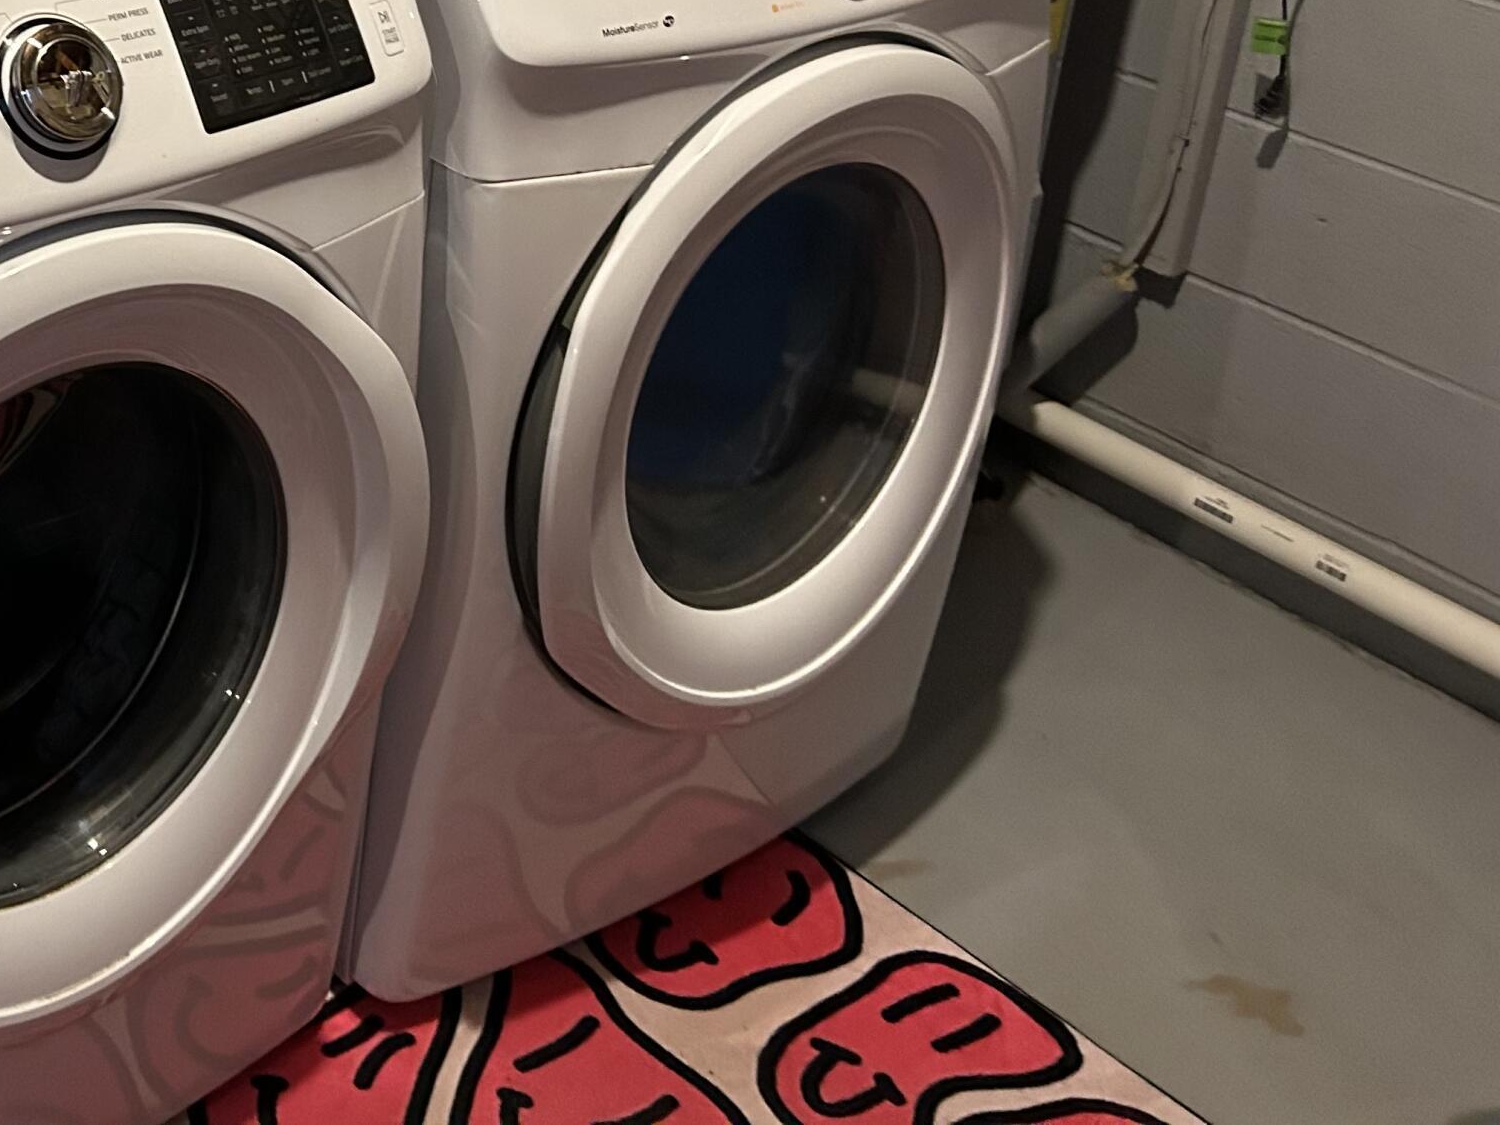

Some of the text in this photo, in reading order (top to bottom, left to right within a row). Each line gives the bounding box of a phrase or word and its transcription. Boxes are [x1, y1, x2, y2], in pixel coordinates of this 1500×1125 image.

[108, 7, 149, 21] PERM PRESS
[121, 28, 156, 42] DELICATES
[121, 49, 164, 64] ACTIVE WEAR
